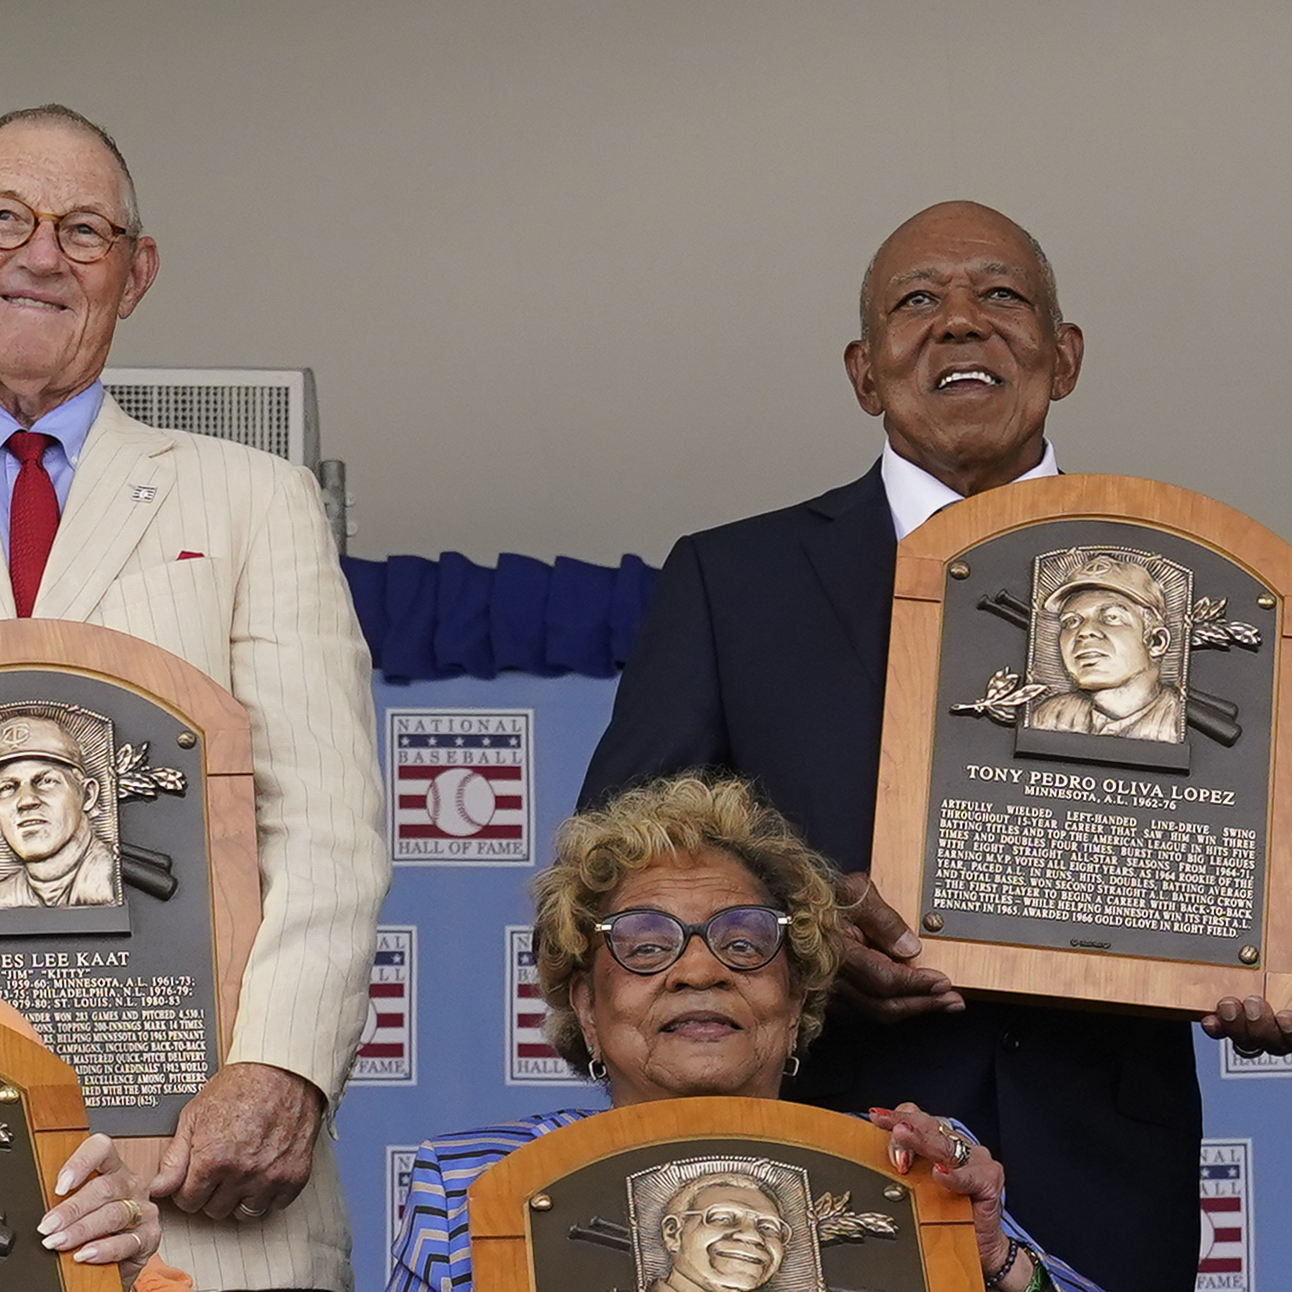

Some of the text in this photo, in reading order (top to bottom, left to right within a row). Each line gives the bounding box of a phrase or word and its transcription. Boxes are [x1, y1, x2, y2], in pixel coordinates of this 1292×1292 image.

[398, 719, 522, 733] NATIONAL
[398, 751, 523, 764] BASEBALL
[966, 765, 1236, 805] TONY PEDRO OLIVA LOPEZ
[398, 841, 523, 854] HALL OF FAME
[32, 953, 69, 967] LEE
[76, 951, 129, 966] KAAT
[359, 1060, 405, 1074] FAME
[517, 1060, 565, 1074] HALL
[1197, 1275, 1243, 1290] FAME
